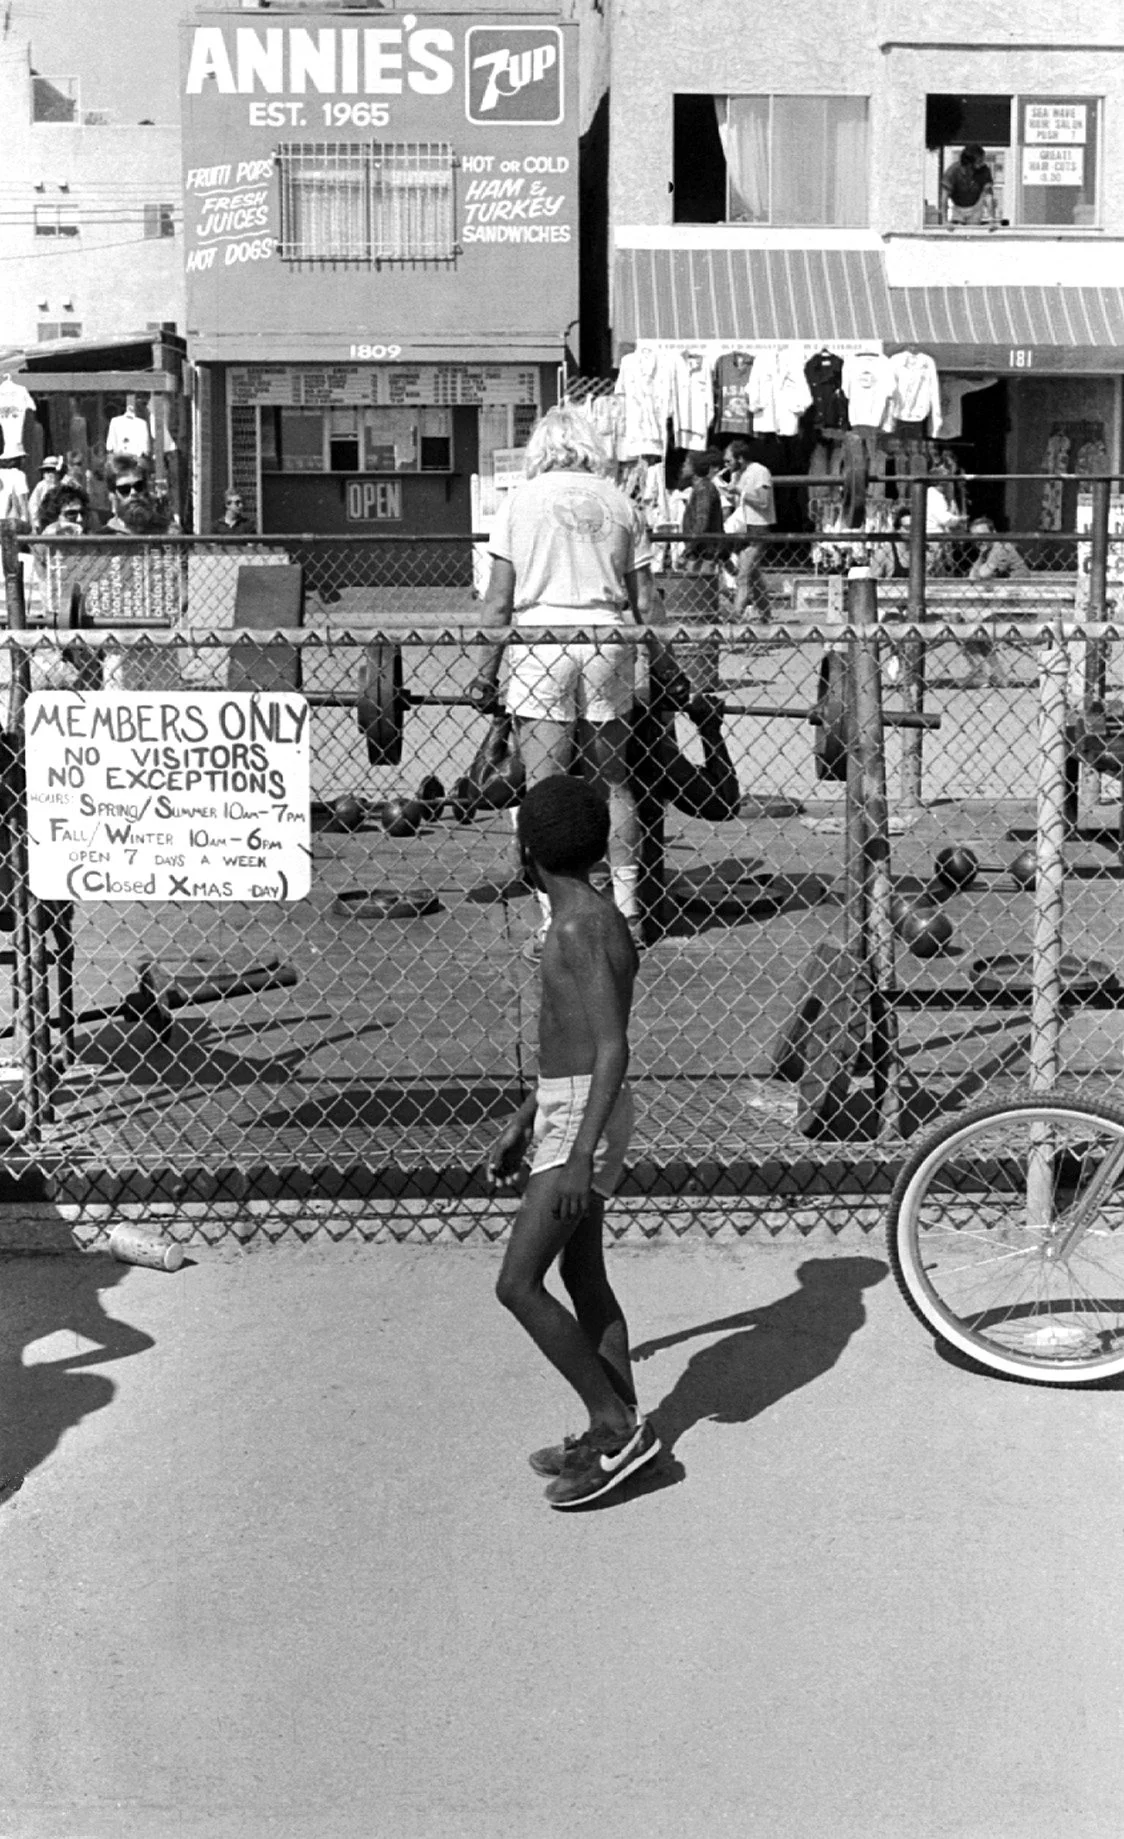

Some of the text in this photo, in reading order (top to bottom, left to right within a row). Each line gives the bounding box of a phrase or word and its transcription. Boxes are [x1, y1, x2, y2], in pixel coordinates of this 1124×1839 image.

[185, 14, 454, 94] ANNIE'S
[249, 102, 390, 126] EST. 1965
[236, 159, 273, 183] POPS
[462, 155, 494, 173] HOT
[523, 156, 569, 173] COLD
[465, 178, 526, 201] HAM
[201, 191, 268, 214] FRESH
[465, 195, 565, 223] TURKEY
[196, 205, 269, 236] JUICES
[462, 224, 571, 242] SANDWICHES
[186, 237, 272, 272] HOT DOGS
[350, 344, 402, 359] 1809
[1010, 350, 1032, 367] 181
[350, 483, 400, 518] OPEN
[31, 701, 307, 744] MEMBERS ONLY
[64, 743, 269, 772] NO VISITORS
[47, 765, 287, 800] NO EXCEPTIONS
[68, 848, 268, 868] OPEN 7 DAYS A WEEK
[168, 874, 233, 898] XMAS
